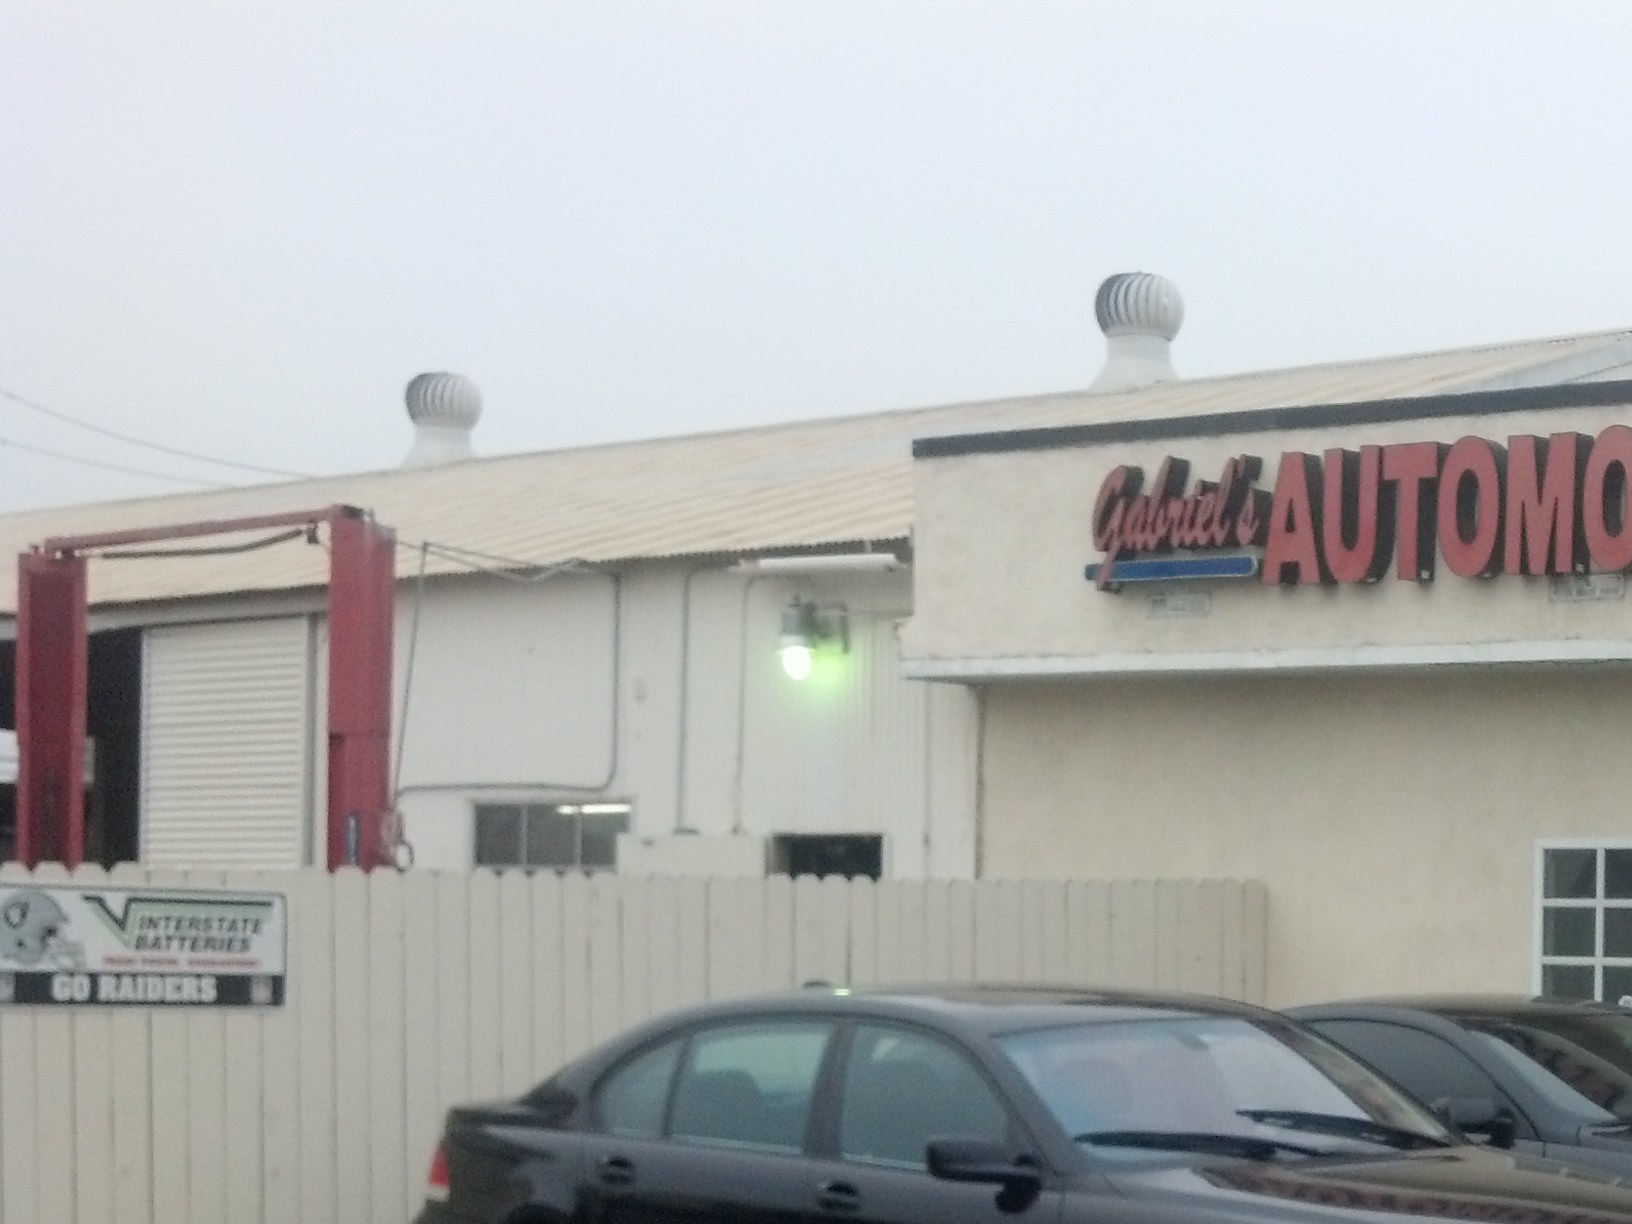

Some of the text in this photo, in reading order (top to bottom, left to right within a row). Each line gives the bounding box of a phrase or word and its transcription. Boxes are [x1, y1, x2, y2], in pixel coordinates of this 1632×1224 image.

[138, 916, 262, 935] INTERSTATE
[135, 934, 250, 952] BATTERIES
[98, 973, 217, 1001] RAIDERS
